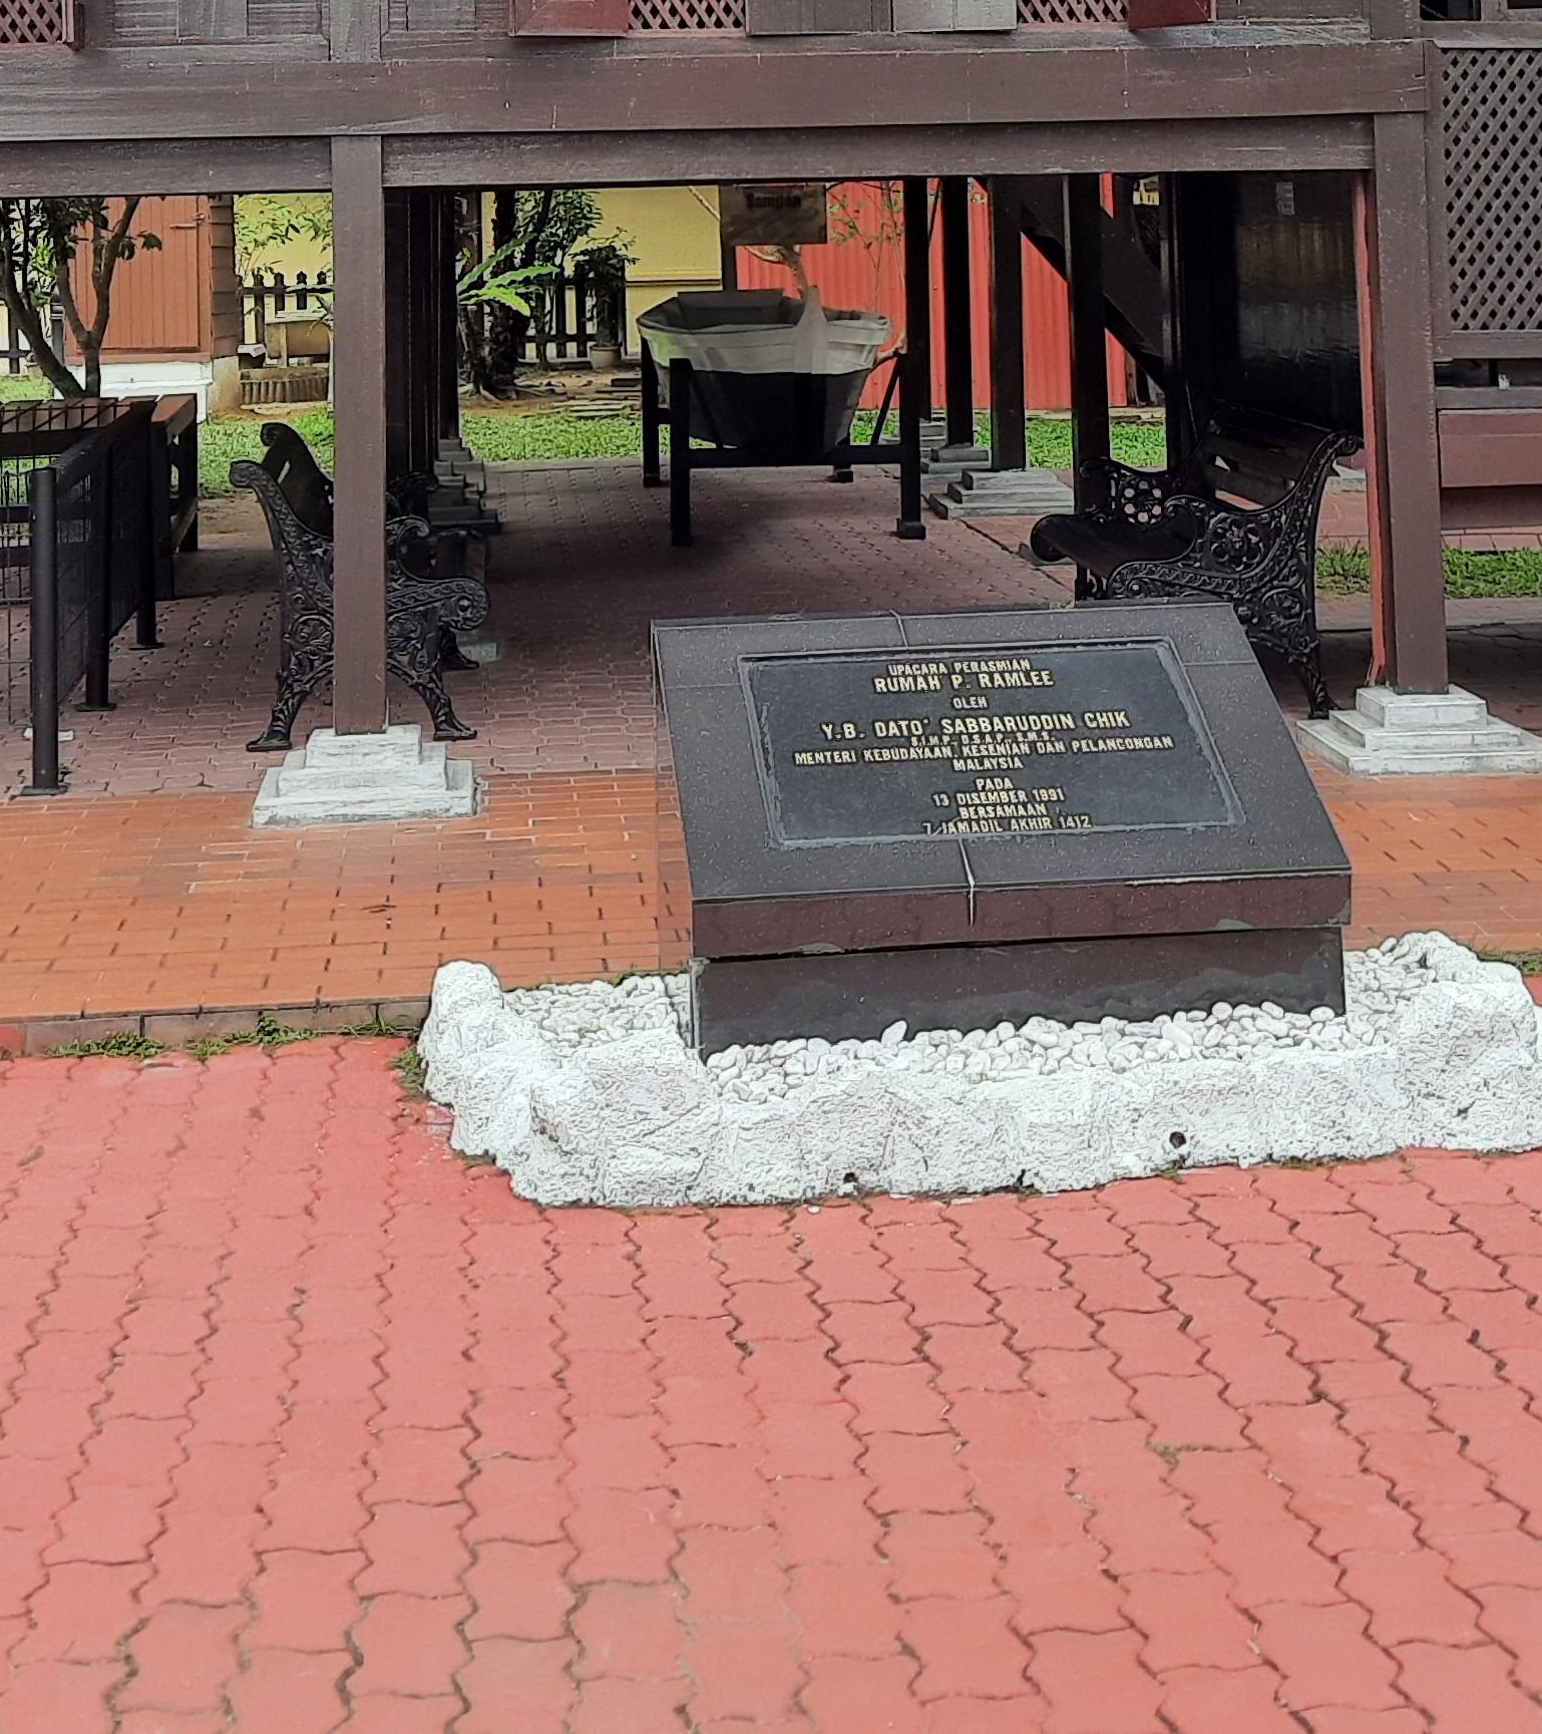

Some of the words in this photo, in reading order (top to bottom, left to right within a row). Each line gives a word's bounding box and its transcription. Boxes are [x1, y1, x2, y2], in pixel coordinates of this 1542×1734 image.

[888, 663, 948, 676] UPACARA
[954, 659, 1031, 673] PERASMIAN
[874, 676, 942, 693] RUMAH
[951, 674, 972, 689] P.
[978, 670, 1054, 688] RAMLEE
[953, 697, 988, 709] OLEH
[821, 722, 866, 740] Y.B.
[941, 713, 1075, 734] SABBARUDDIN
[1084, 711, 1131, 729] CHIK
[794, 750, 857, 765] MENTERI
[962, 742, 1031, 757] KESENIAN
[1037, 741, 1067, 754] DAN
[1072, 736, 1175, 753] PELANCONGAN
[953, 757, 1024, 772] MALAYSIA
[976, 778, 1014, 790] PADA
[933, 794, 950, 806] 13
[957, 790, 1028, 805] DISEMBER
[1032, 787, 1065, 801] 1991
[959, 803, 1048, 819] BERSAMAAN
[1011, 817, 1053, 831] AKHIR
[1059, 815, 1092, 829] 1412
